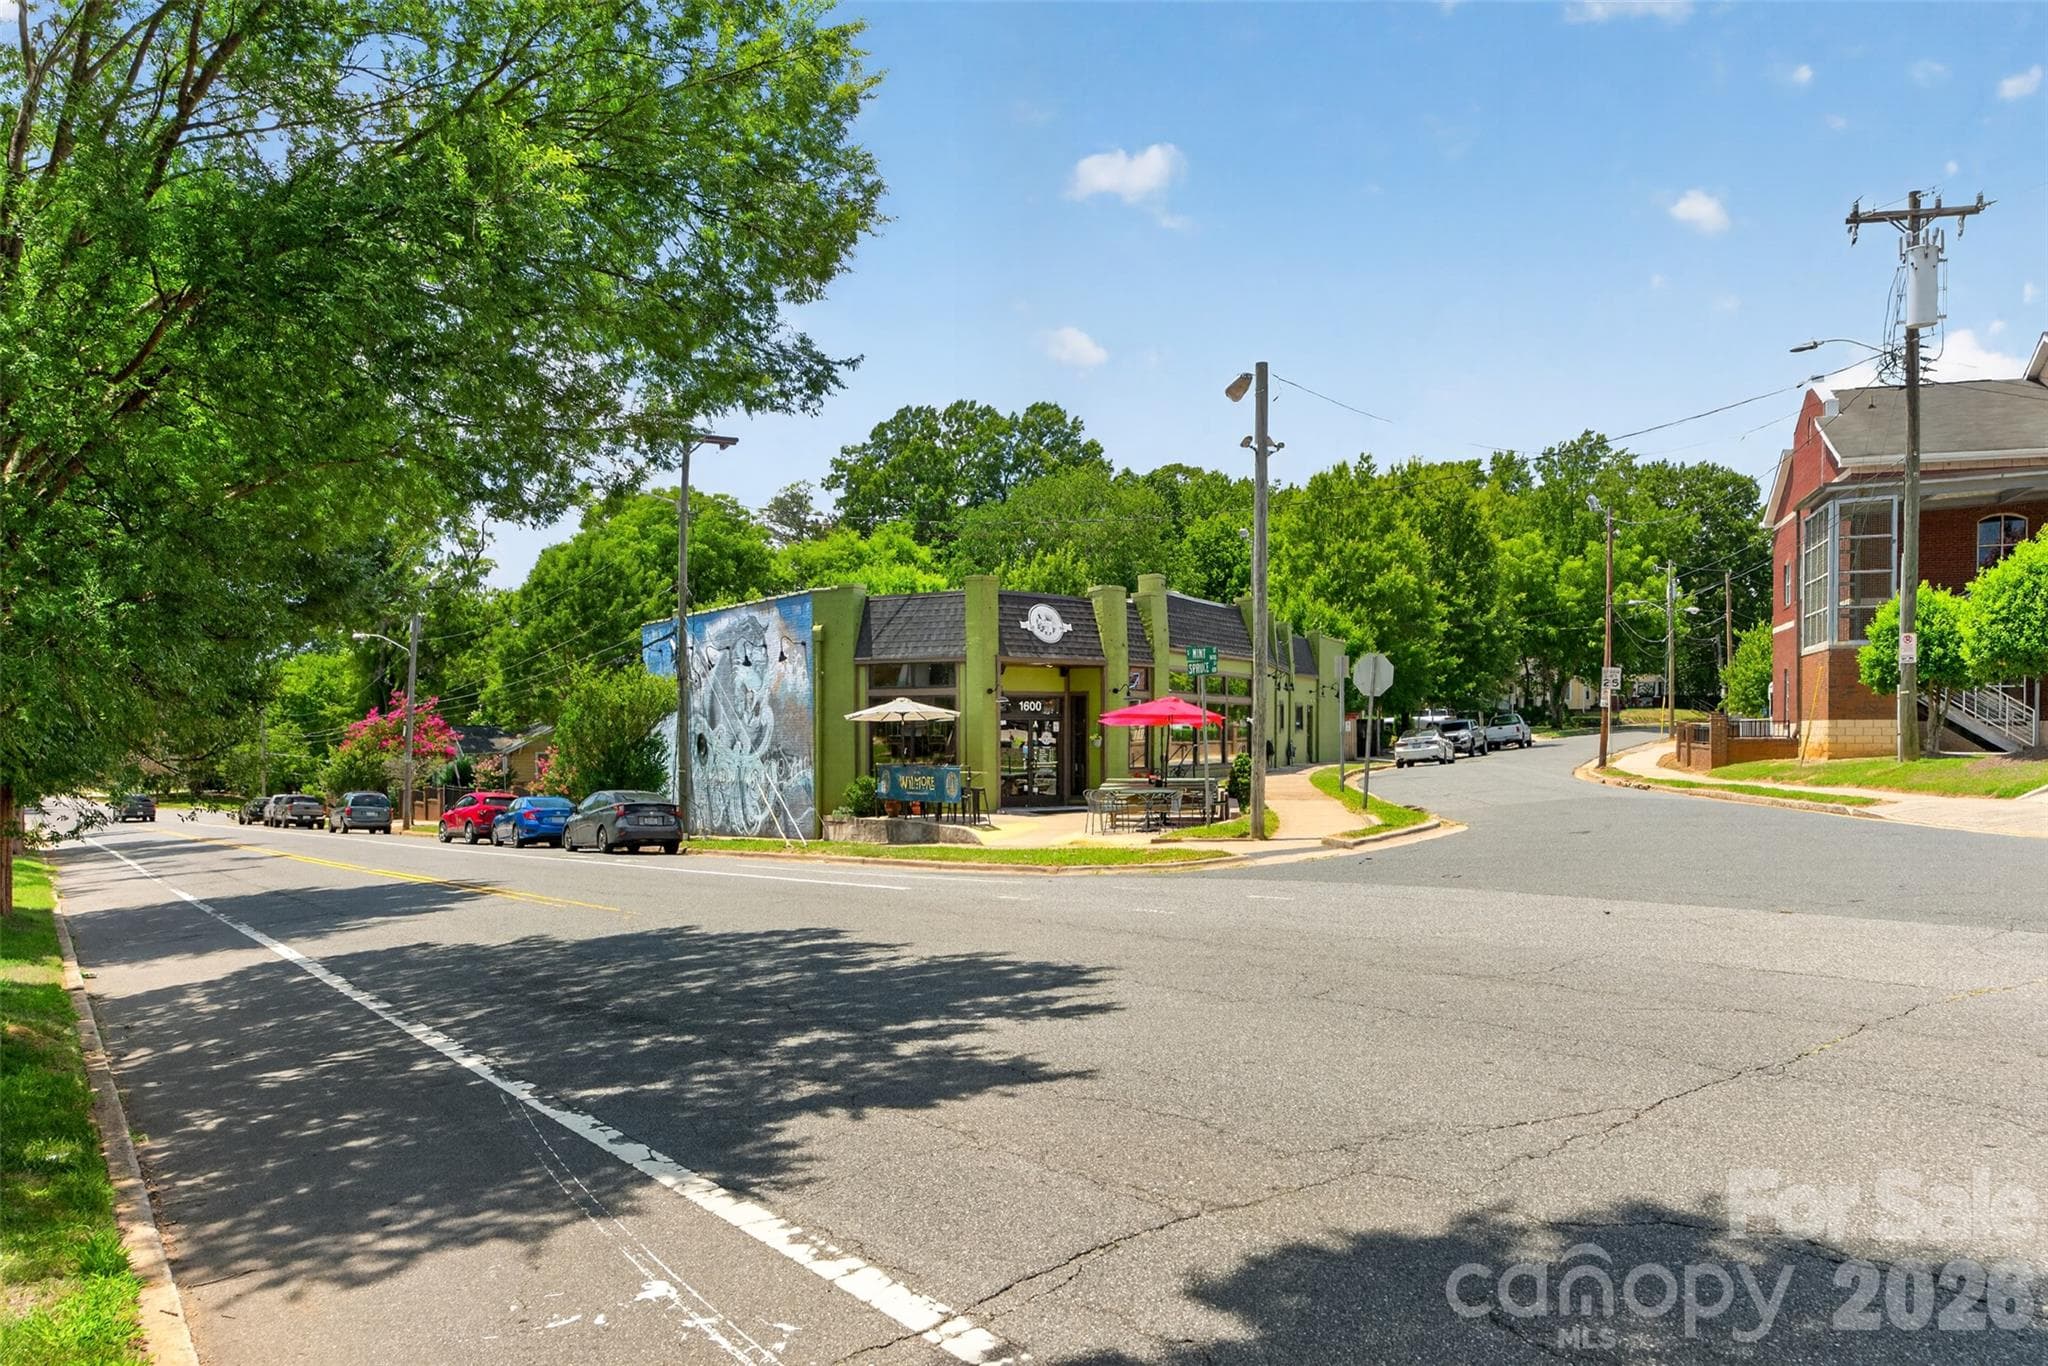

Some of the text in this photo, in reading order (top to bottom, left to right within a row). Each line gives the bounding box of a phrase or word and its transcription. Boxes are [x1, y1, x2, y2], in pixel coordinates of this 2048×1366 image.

[1603, 678, 1619, 688] 25
[1019, 701, 1042, 711] 1600
[899, 775, 936, 791] WILMORE
